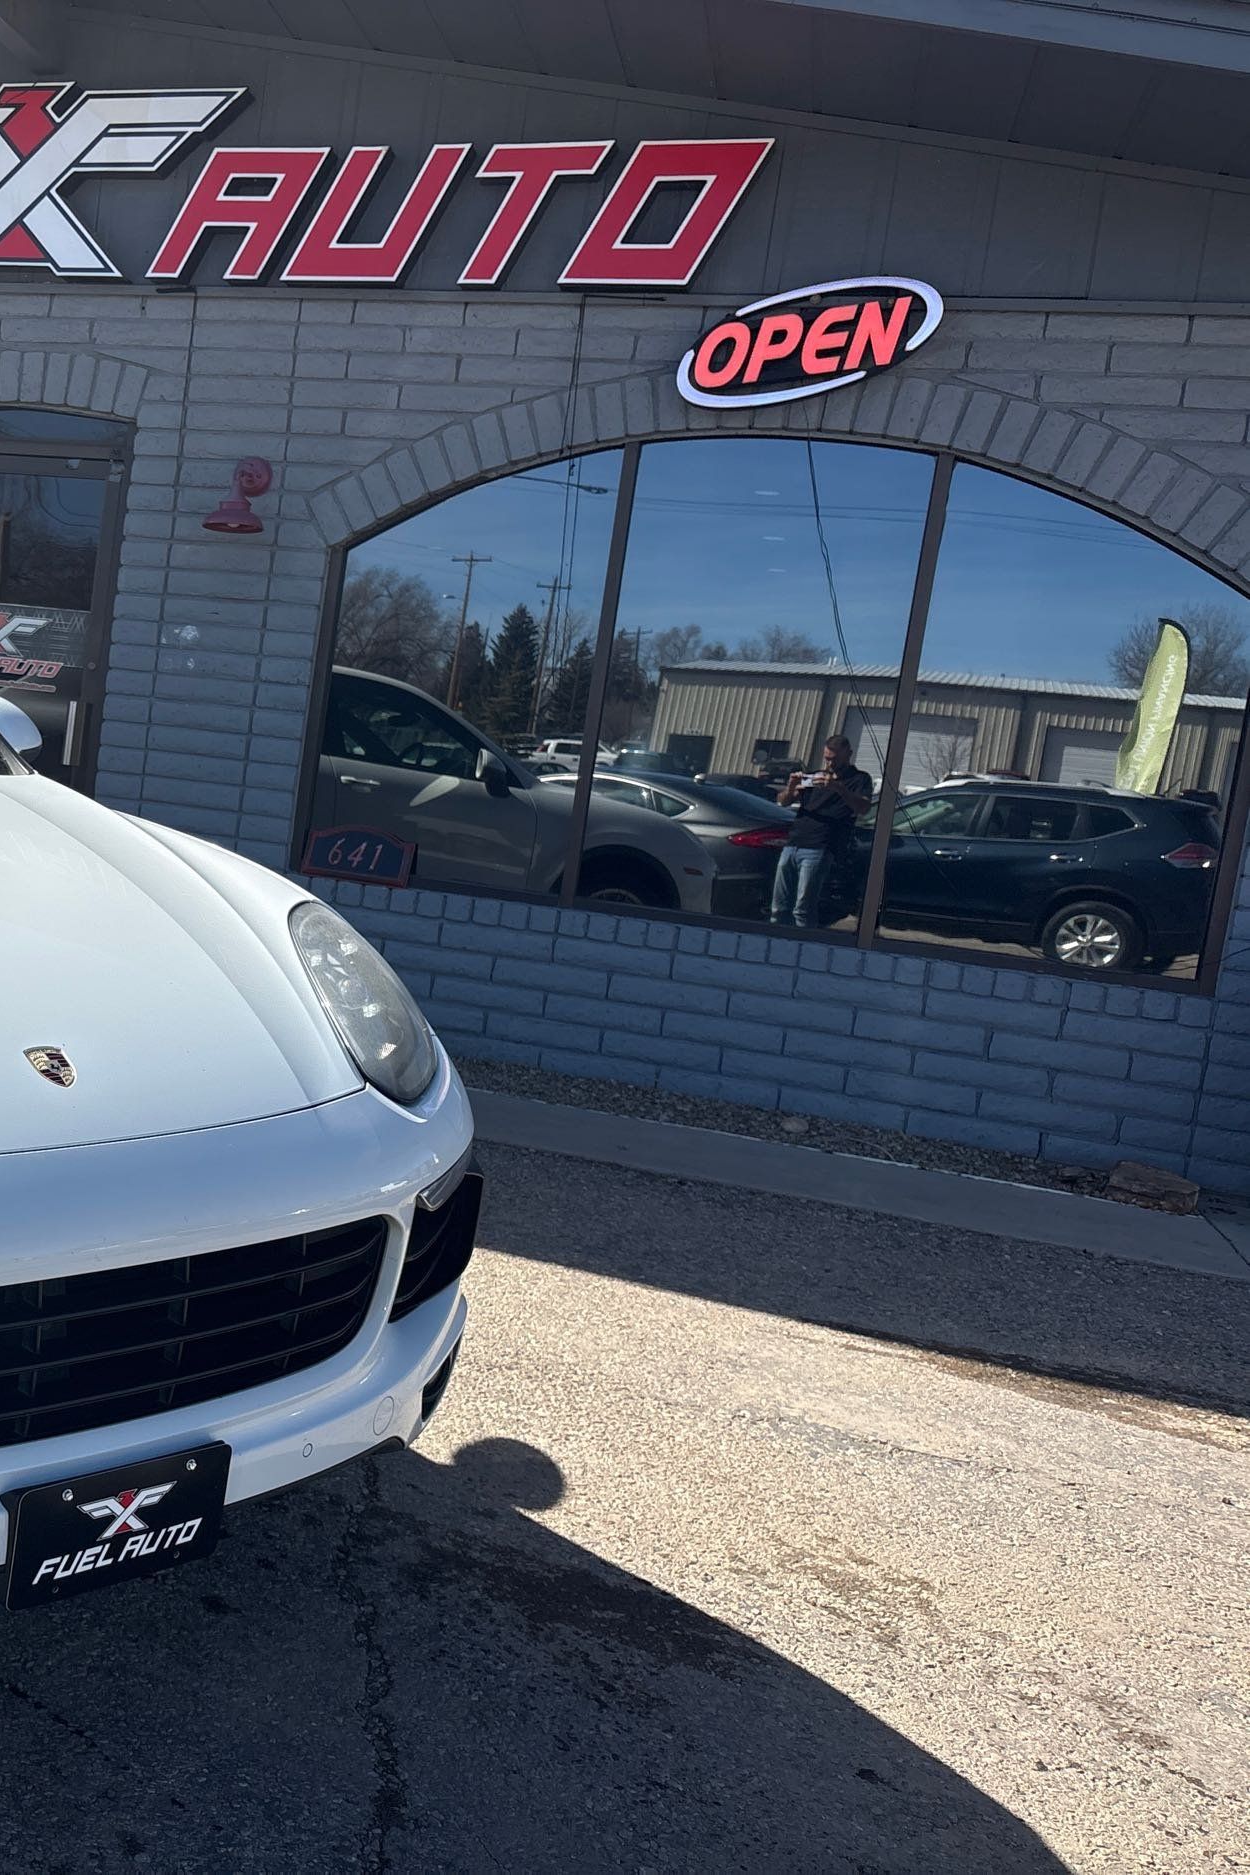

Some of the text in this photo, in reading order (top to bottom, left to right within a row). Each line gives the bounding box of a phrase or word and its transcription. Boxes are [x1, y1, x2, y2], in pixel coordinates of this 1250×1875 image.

[145, 136, 776, 288] AUTO
[693, 295, 913, 389] OPEN
[327, 837, 384, 871] 641
[31, 1516, 203, 1586] FUEL AUTO
